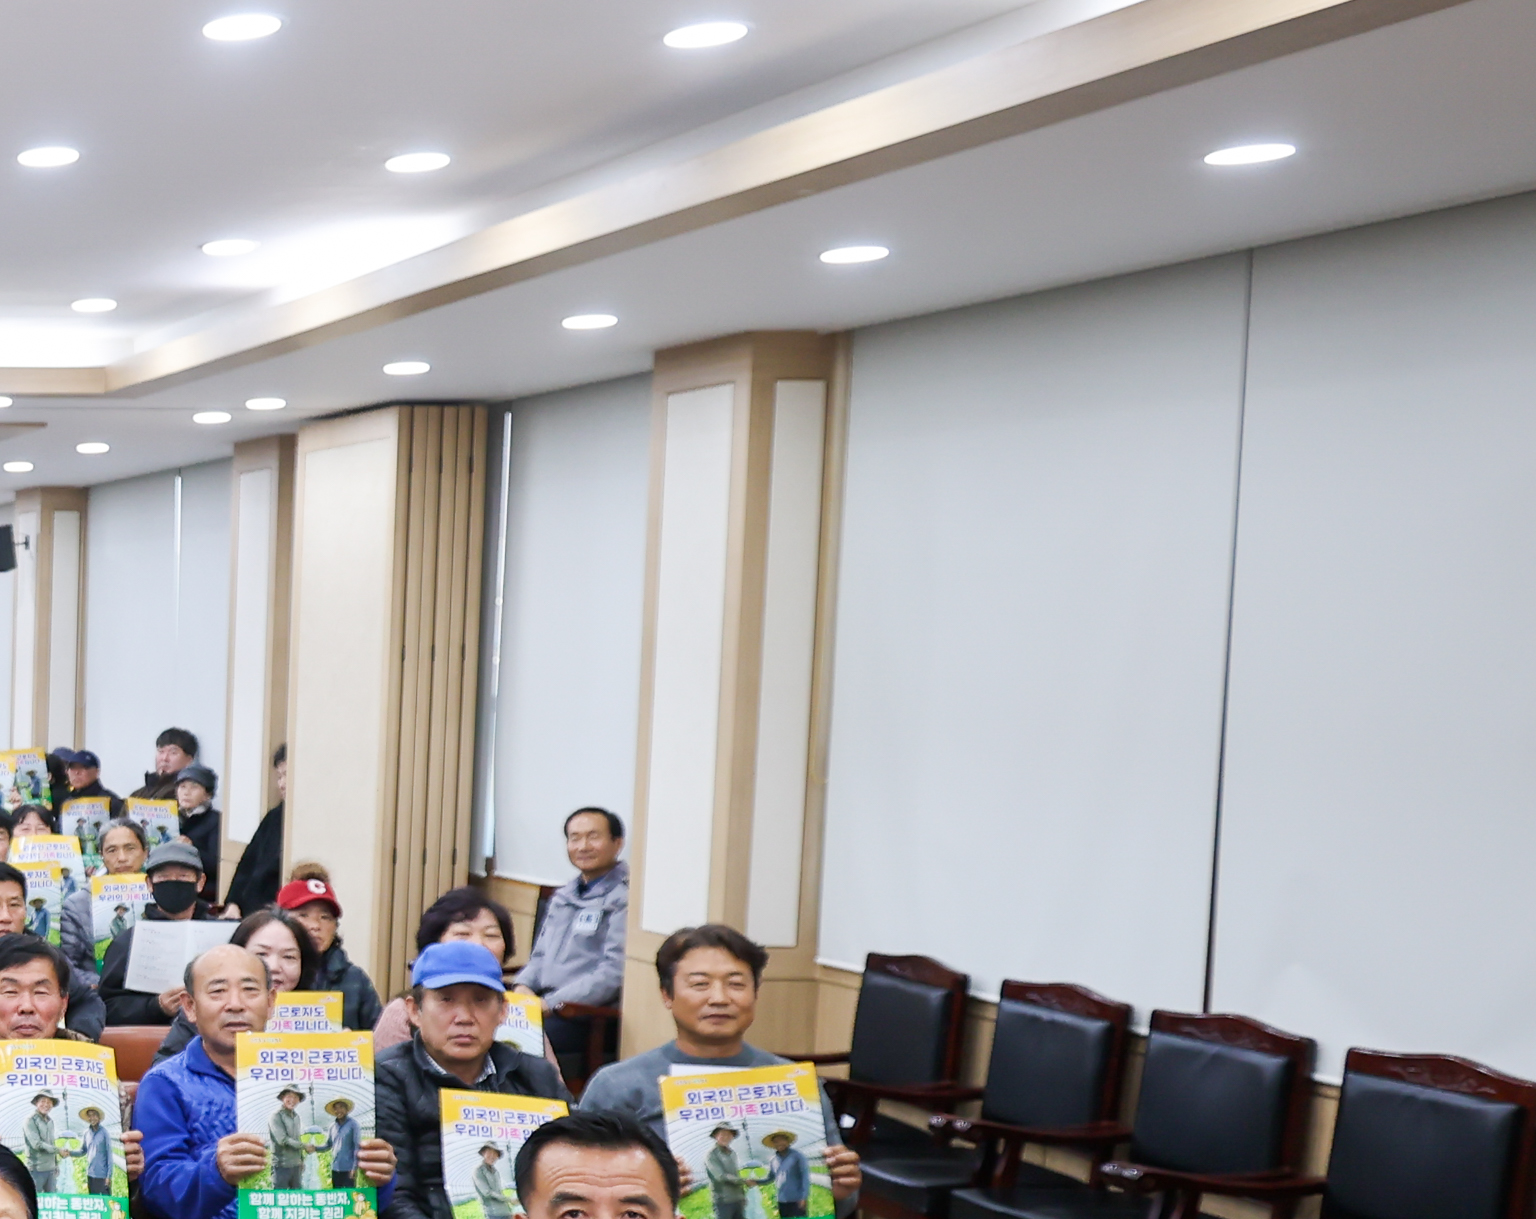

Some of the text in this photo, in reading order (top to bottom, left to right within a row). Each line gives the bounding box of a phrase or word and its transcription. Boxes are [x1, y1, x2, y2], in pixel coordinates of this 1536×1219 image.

[279, 1007, 324, 1018] 근로자도
[271, 1020, 332, 1031] 가족입니다.
[259, 1049, 358, 1065] 외국인 근로자도
[14, 1056, 104, 1074] 외국인 근로자도
[5, 1073, 47, 1087] 우리의
[250, 1067, 365, 1082] 우리의 가족입니다.
[687, 1083, 797, 1106] 외국인 근로자도
[462, 1107, 500, 1123] 외국인
[679, 1098, 810, 1123] 우리의 가족입니다.
[454, 1123, 493, 1139] 우리의
[251, 1193, 353, 1206] 함께 일하는 동반자,
[259, 1207, 346, 1219] 함께 지키는 권리
